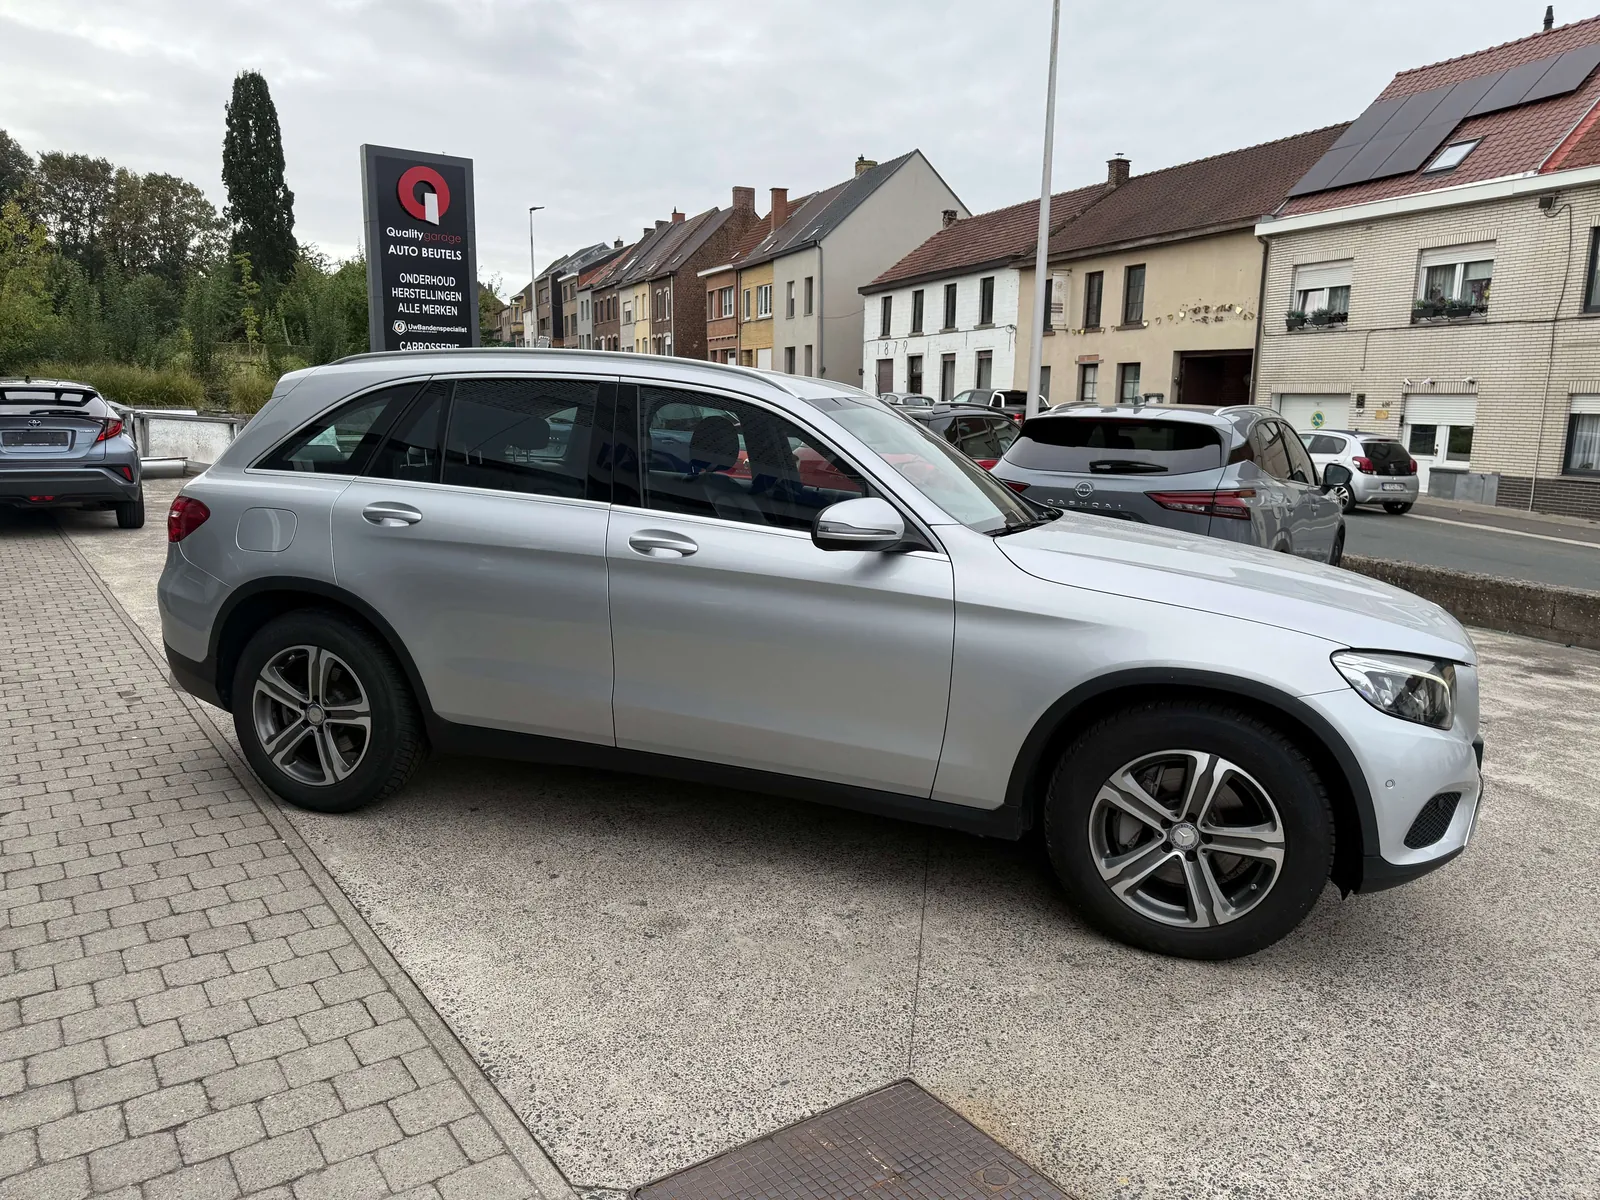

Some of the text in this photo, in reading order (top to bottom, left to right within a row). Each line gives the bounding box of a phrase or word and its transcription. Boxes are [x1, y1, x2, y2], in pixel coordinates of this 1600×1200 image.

[386, 226, 462, 244] Qualitygarage
[388, 244, 462, 260] AUTO BEUTELS
[399, 272, 456, 286] ONDERHOUD
[391, 286, 462, 302] HERSTELLINGEN
[397, 302, 458, 316] ALLE MERKEN
[877, 340, 908, 355] 1879
[1046, 498, 1122, 508] QASHQAI
